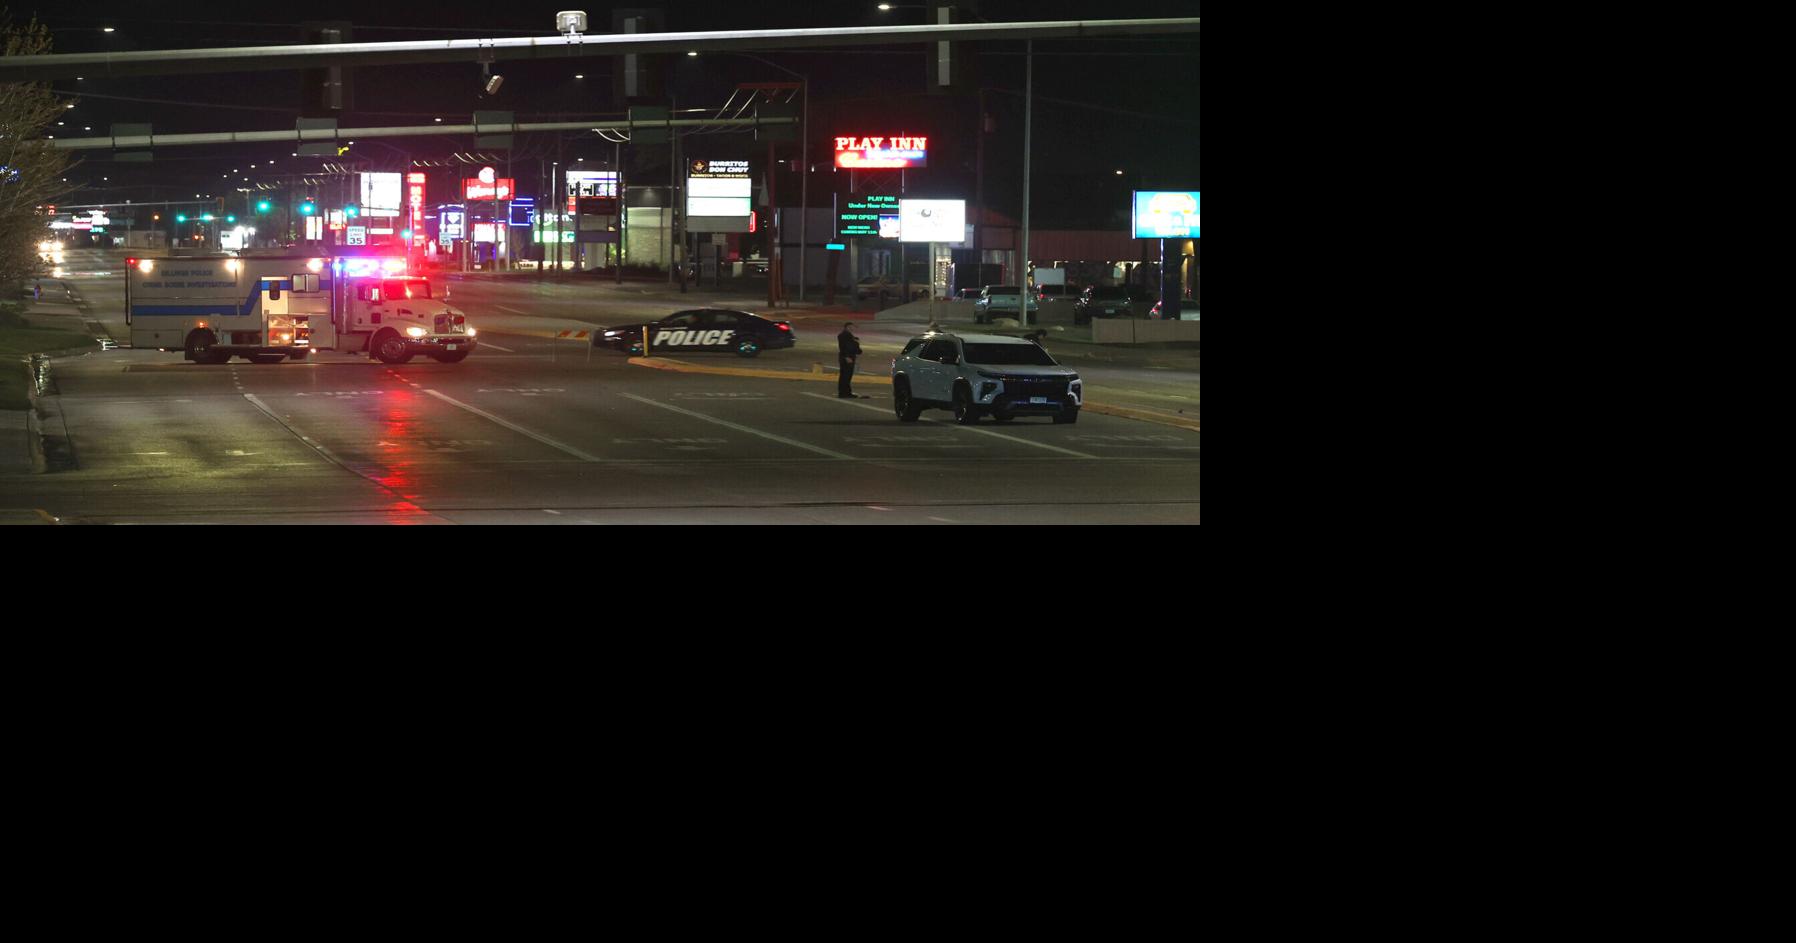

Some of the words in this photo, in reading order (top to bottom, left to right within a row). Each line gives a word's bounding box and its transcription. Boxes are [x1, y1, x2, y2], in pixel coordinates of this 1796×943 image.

[836, 138, 883, 150] PLAY
[890, 138, 926, 150] INN
[653, 330, 736, 346] POLICE
